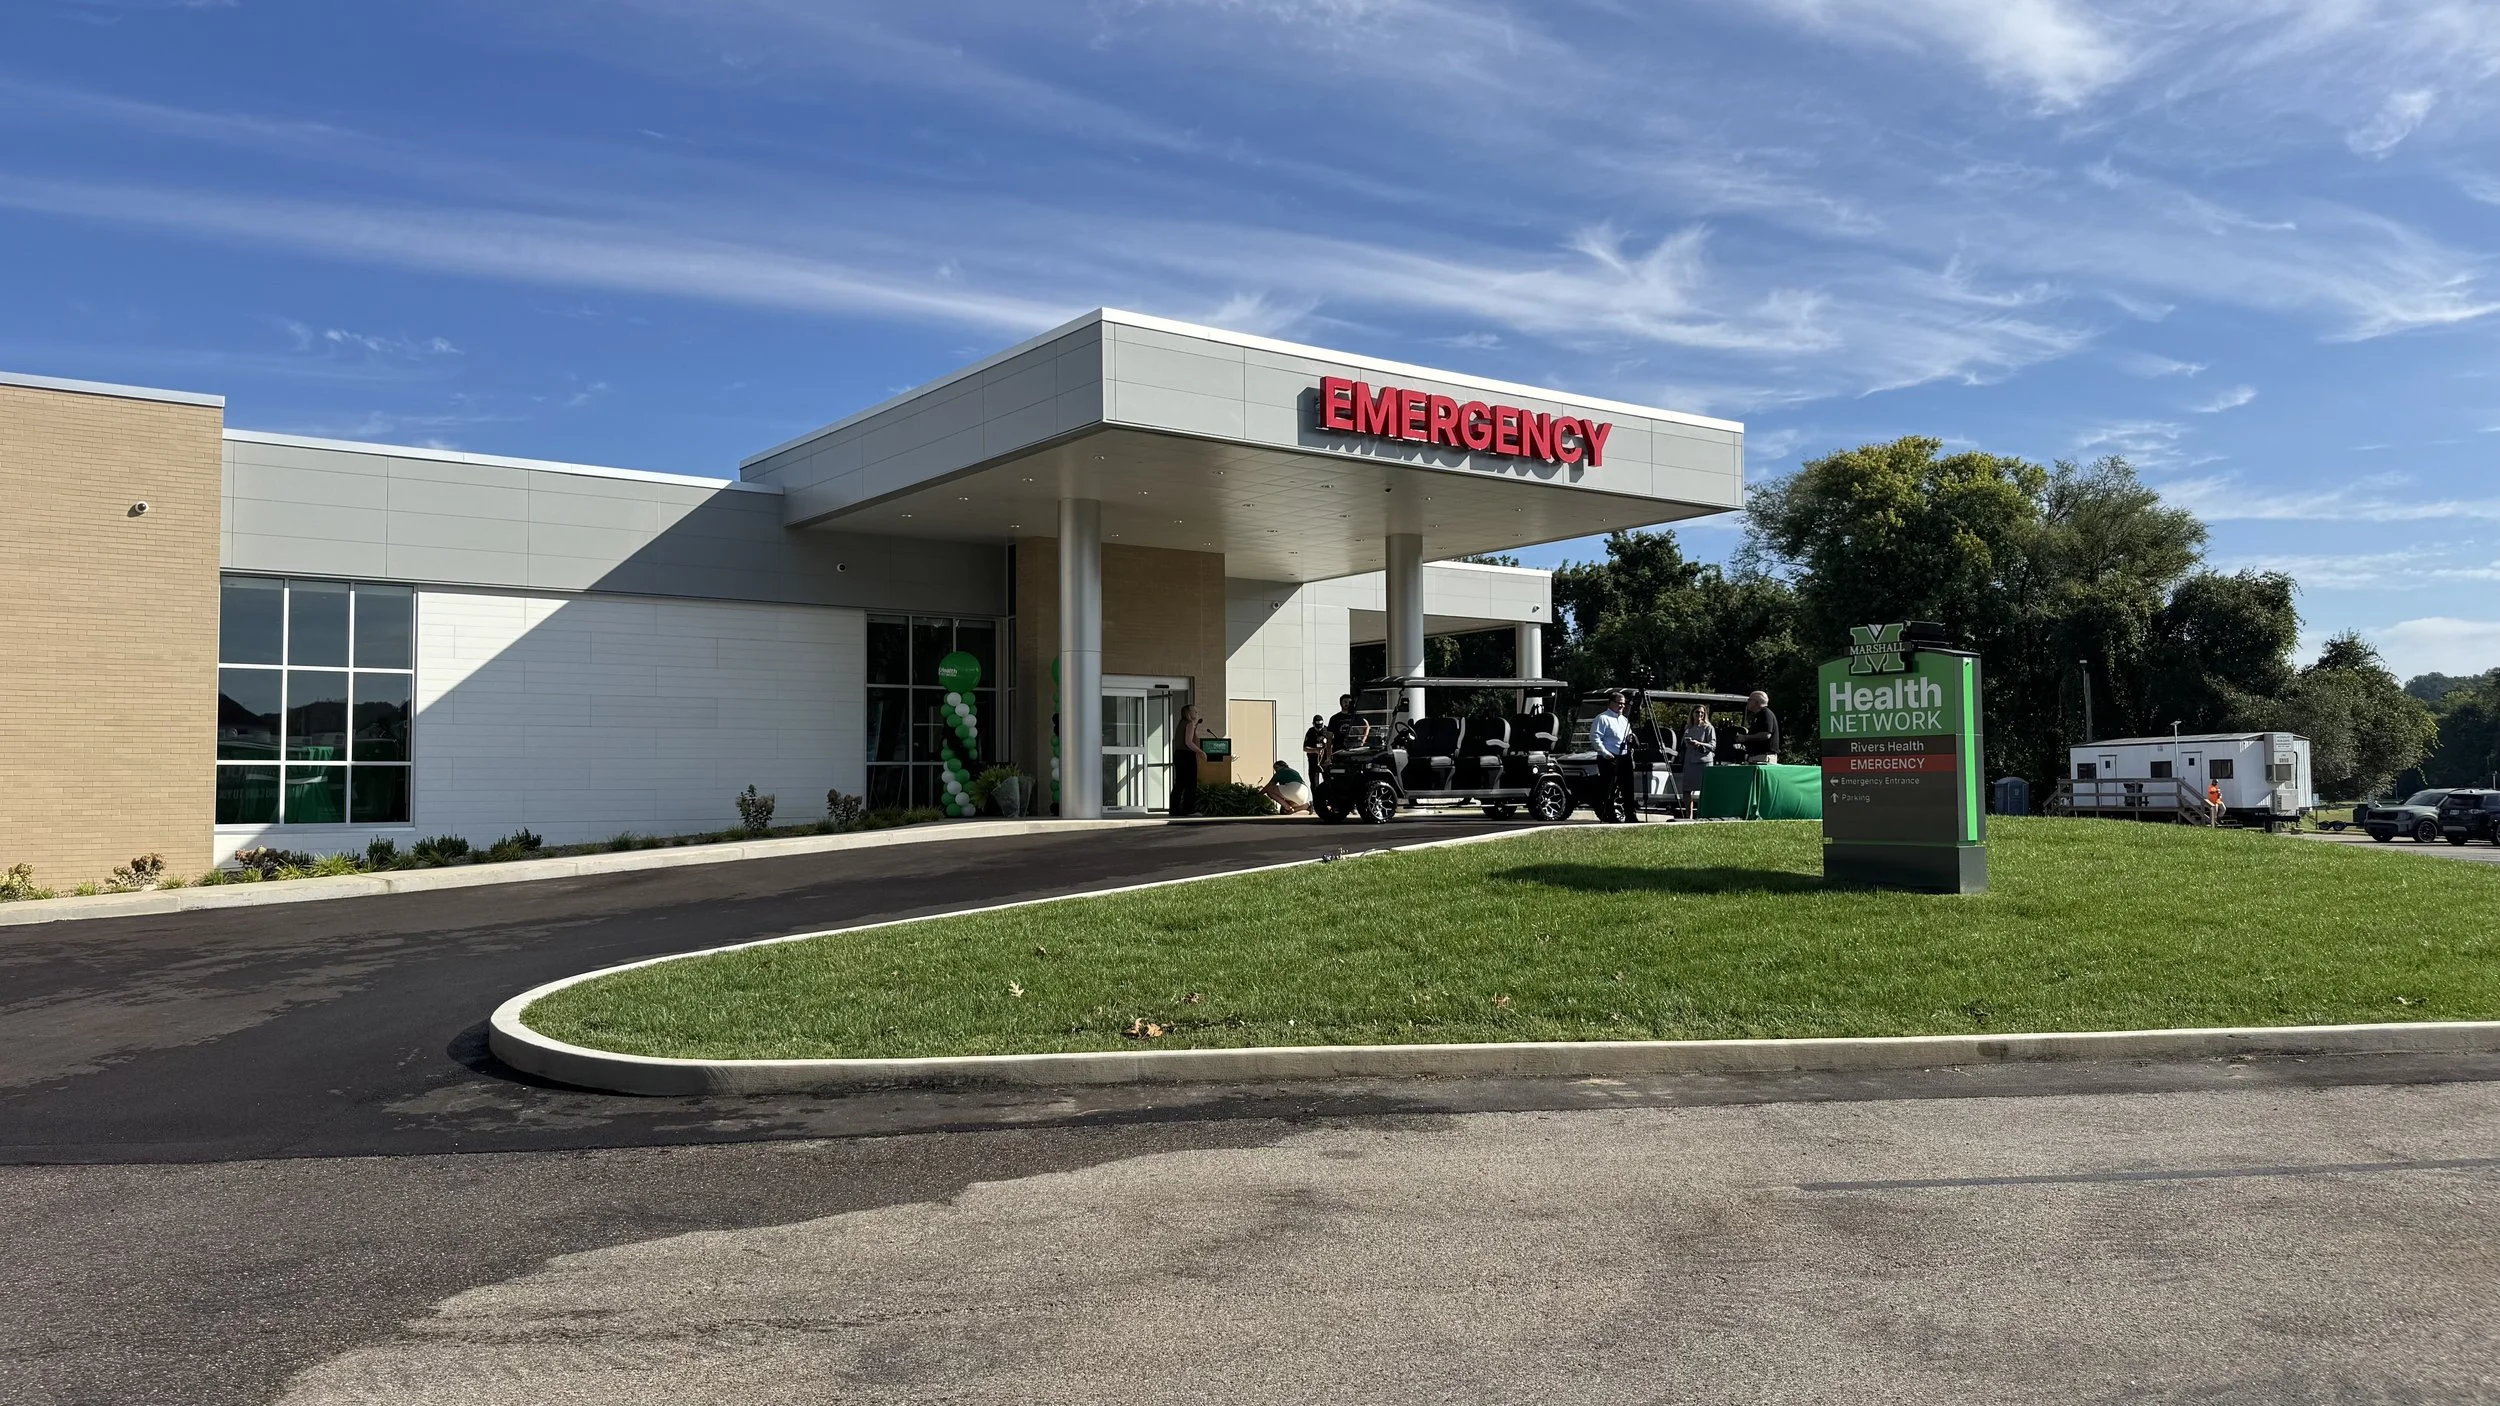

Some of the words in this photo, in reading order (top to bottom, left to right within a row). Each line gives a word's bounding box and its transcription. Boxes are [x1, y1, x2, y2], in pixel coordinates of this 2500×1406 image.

[1320, 376, 1611, 466] EMERGENCY
[1849, 642, 1905, 656] MARSHALL
[1829, 677, 1942, 712] Health
[1830, 711, 1942, 732] NETWORK
[1850, 742, 1885, 753] Rivers
[1887, 740, 1924, 752] Health
[1850, 757, 1925, 770] EMERGENCY
[1841, 777, 1883, 787] Emergency
[1885, 776, 1920, 785] Entrance
[1841, 793, 1871, 803] Parking
